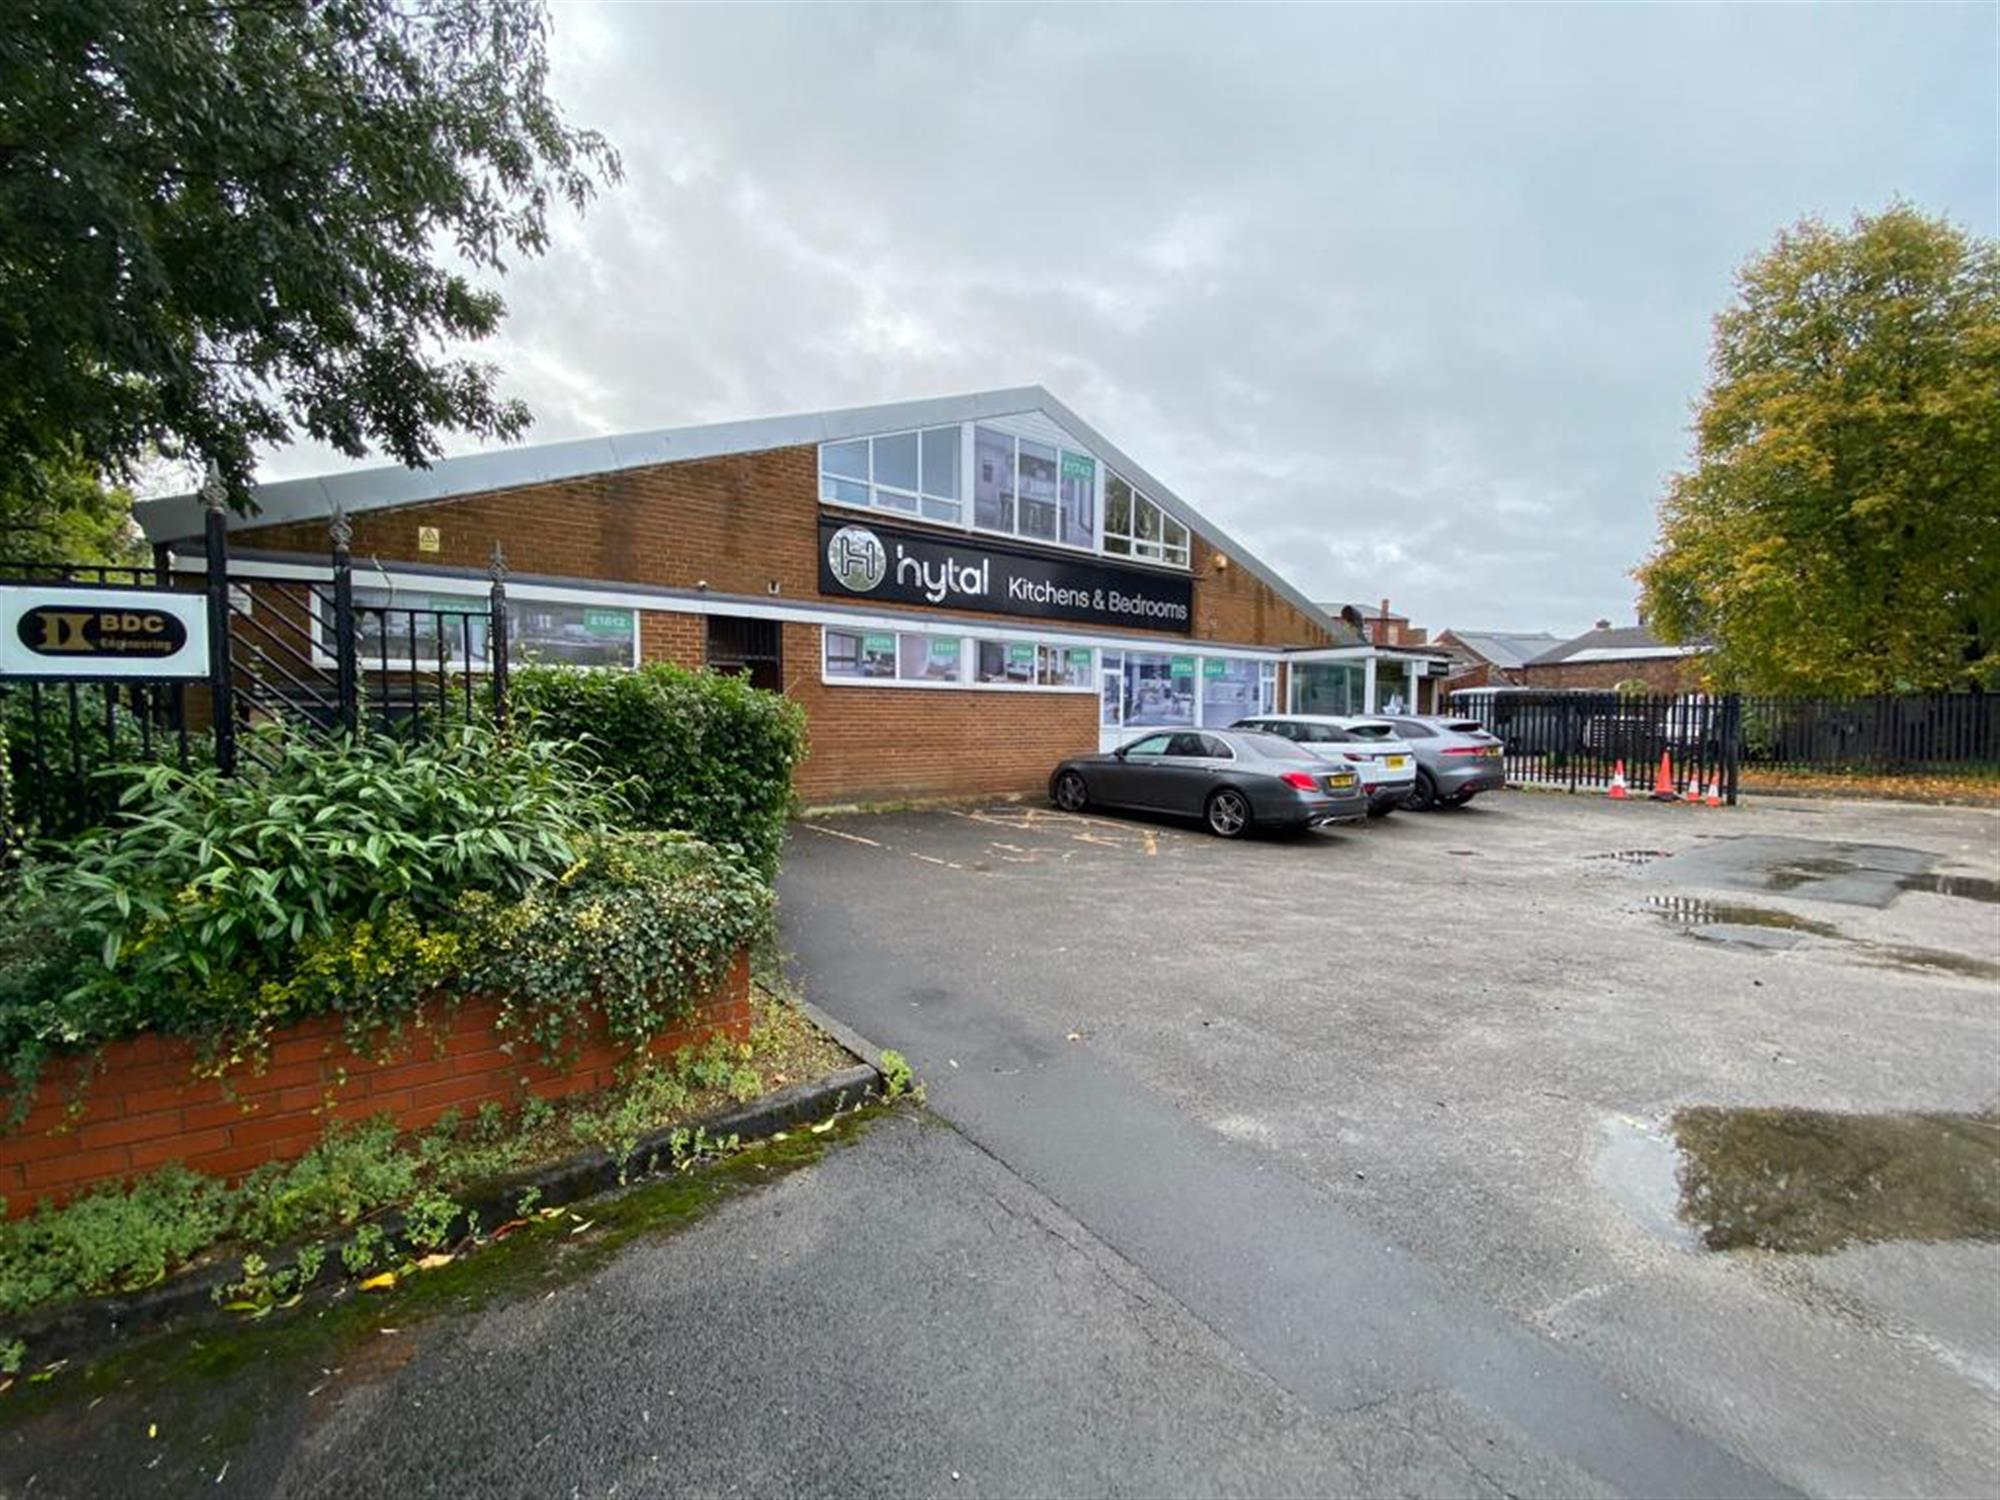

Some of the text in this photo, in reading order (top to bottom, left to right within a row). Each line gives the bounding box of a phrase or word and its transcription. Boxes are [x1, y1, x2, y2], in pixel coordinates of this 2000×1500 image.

[897, 544, 1188, 621] hytal Kitchens & Bedrooms
[100, 614, 172, 651] BDC Engineering
